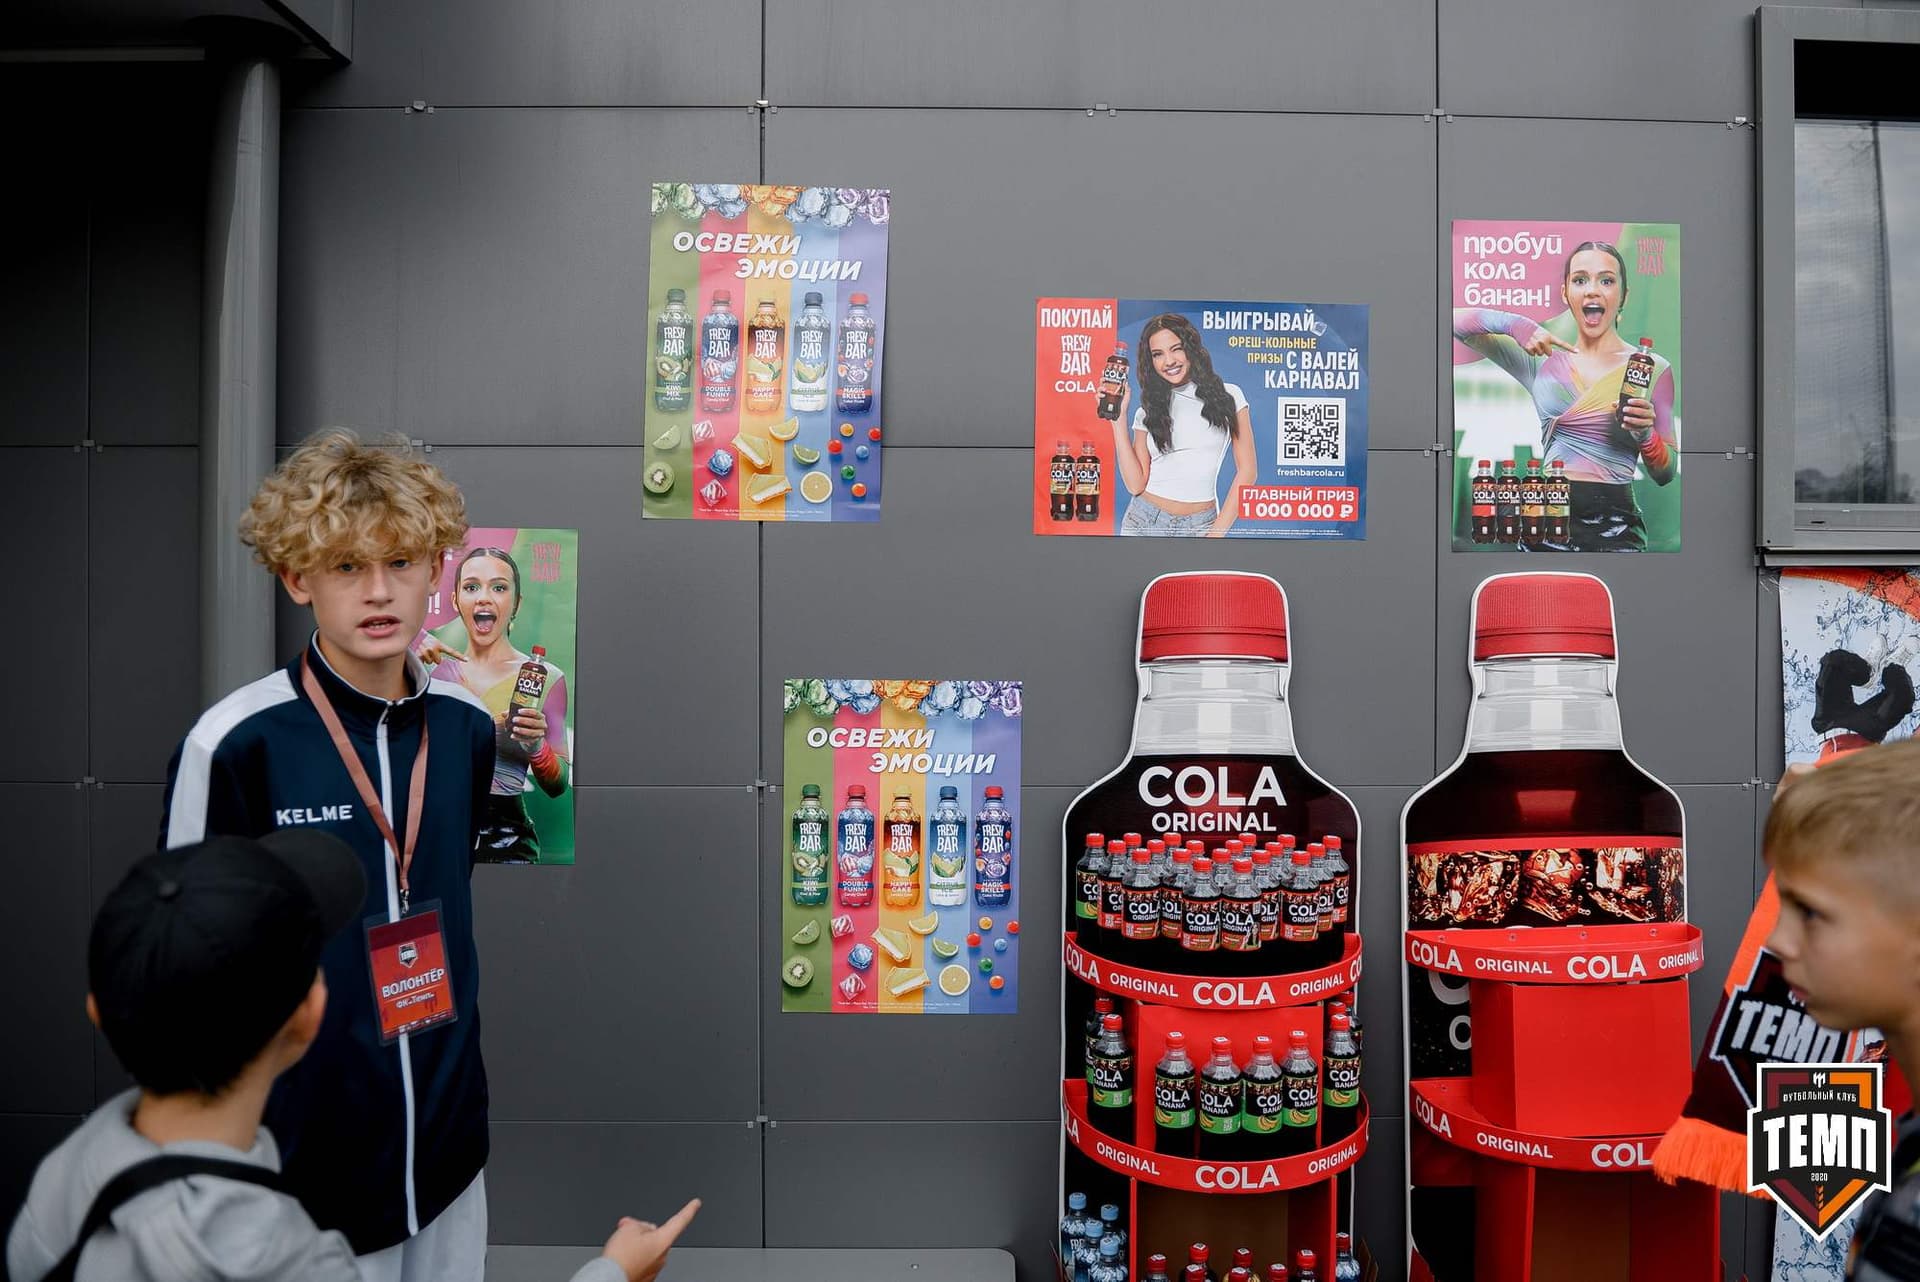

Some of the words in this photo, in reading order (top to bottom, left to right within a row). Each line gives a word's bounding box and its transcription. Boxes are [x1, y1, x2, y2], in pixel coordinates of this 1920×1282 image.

[672, 231, 803, 256] ОСВЕЖИ
[1463, 232, 1563, 260] пробуй
[735, 258, 863, 283] ЭМОЦИИ
[1464, 261, 1526, 280] кола
[1464, 284, 1551, 307] банан!
[1040, 305, 1113, 329] ПОКУПАЙ
[1203, 309, 1315, 332] ВЫИГРЫВАЙ
[664, 326, 686, 339] FRESH
[709, 328, 731, 341] FRESH
[755, 330, 777, 342] FRESH
[801, 330, 823, 343] FRESH
[846, 330, 868, 343] FRESH
[663, 339, 685, 356] BAR
[709, 341, 730, 357] BAR
[755, 342, 777, 358] BAR
[1061, 335, 1091, 353] FRESH
[1228, 336, 1317, 349] ФРЕШ-КОЛЬНЫЕ
[800, 343, 822, 359] BAR
[845, 343, 867, 360] BAR
[1247, 352, 1283, 364] ПРИЗЫ
[1301, 348, 1359, 370] ВАЛЕЙ
[1060, 352, 1091, 376] BAR
[1264, 370, 1360, 390] КАРНАВАЛ
[1627, 369, 1650, 382] COLA
[1054, 380, 1096, 393] COLA
[1051, 470, 1073, 478] COLA
[1277, 468, 1345, 477] freshbarcola.ru
[1242, 487, 1313, 500] ГЛАВНЫЙ
[1317, 490, 1355, 502] ПРИЗ
[1473, 491, 1496, 500] COLA
[1498, 491, 1520, 500] COLA
[1522, 491, 1544, 500] COLA
[1547, 491, 1569, 500] COLA
[1242, 503, 1250, 517] 1
[1255, 503, 1292, 517] 000
[1297, 504, 1334, 518] 000
[518, 677, 542, 691] COLA
[806, 727, 936, 749] ОСВЕЖИ
[868, 752, 996, 776] ЭМОЦИИ
[1138, 766, 1287, 807] COLA
[275, 804, 353, 826] KELME
[1151, 812, 1276, 832] ORIGINAL
[800, 822, 822, 835] FRESH
[845, 823, 867, 836] FRESH
[891, 824, 913, 836] FRESH
[936, 824, 958, 836] FRESH
[982, 824, 1004, 836] FRESH
[799, 835, 822, 852] BAR
[845, 835, 867, 852] BAR
[891, 836, 913, 852] BAR
[936, 836, 958, 852] BAR
[982, 836, 1004, 853] BAR
[1411, 940, 1463, 972] COLA
[1475, 957, 1553, 974] ORIGINAL
[1567, 954, 1647, 980] COLA
[1658, 949, 1699, 970] ORIGINAL
[1065, 943, 1100, 984] COLA
[1110, 972, 1178, 997] ORIGINAL
[1193, 982, 1275, 1005] COLA
[1290, 974, 1344, 997] ORIGINAL
[1350, 957, 1362, 983] CO
[381, 967, 445, 998] ВОЛОНТЁР
[1730, 1000, 1841, 1063] ТЕМП
[1415, 1095, 1452, 1138] COLA
[1476, 1132, 1553, 1159] ORIGINAL
[1591, 1142, 1653, 1168] COL
[1096, 1141, 1160, 1176] ORIGINAL
[1195, 1165, 1280, 1189] COLA
[1308, 1141, 1358, 1174] ORIGINAL
